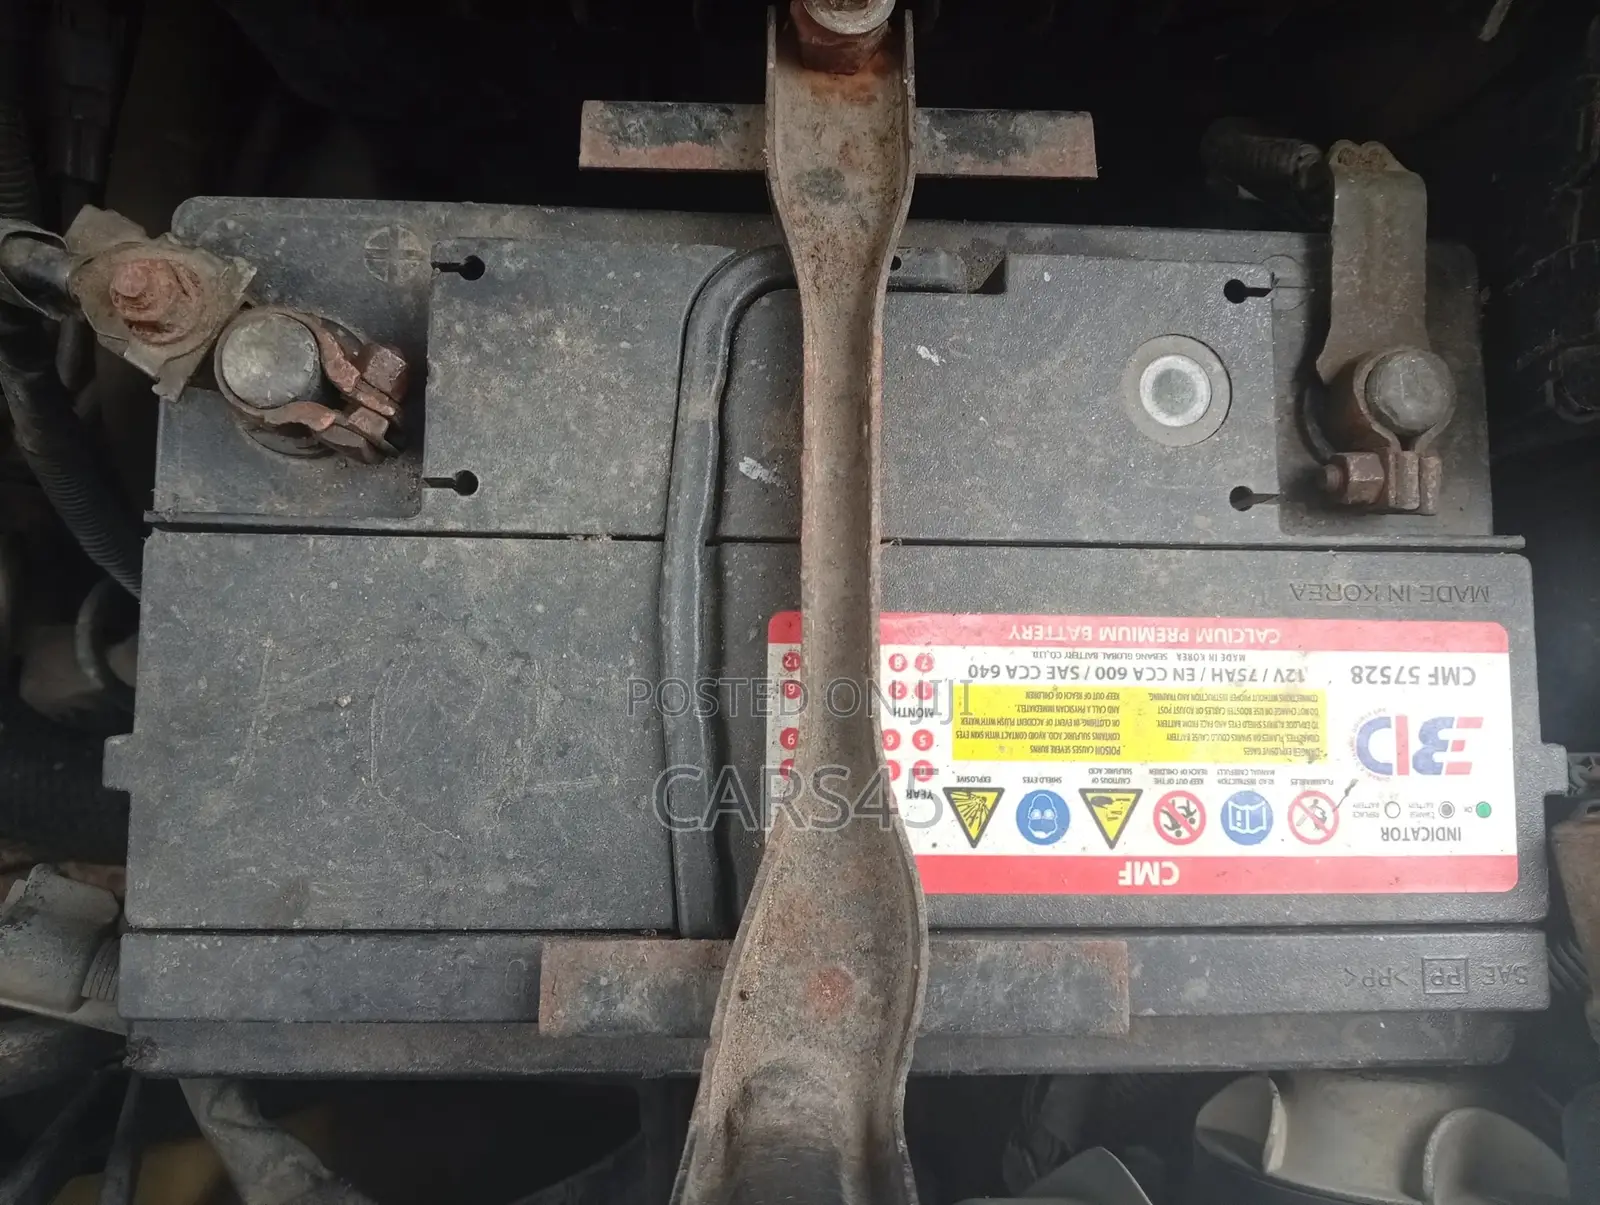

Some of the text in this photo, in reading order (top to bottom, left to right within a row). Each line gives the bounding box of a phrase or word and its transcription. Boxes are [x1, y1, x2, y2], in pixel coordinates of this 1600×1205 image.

[1288, 583, 1490, 603] MADE IN KOREA
[1008, 624, 1281, 644] CALCIUM PREMIUM BATTERY
[1101, 652, 1133, 660] GLOBAL
[1135, 652, 1168, 660] SEBANG
[1176, 653, 1246, 662] MADE IN KOREA
[968, 664, 1306, 683] 12V / 75AH / EN CCA 600 / SAE CCA 640
[1350, 665, 1476, 686] CMF 57528
[893, 708, 934, 718] MONTH
[1030, 744, 1120, 754] POISON CAUSES SEVERE BURNS
[906, 789, 933, 800] YEAR
[1380, 826, 1462, 842] INDICATOR
[1118, 860, 1179, 886] CMF
[1480, 965, 1528, 986] SAE
